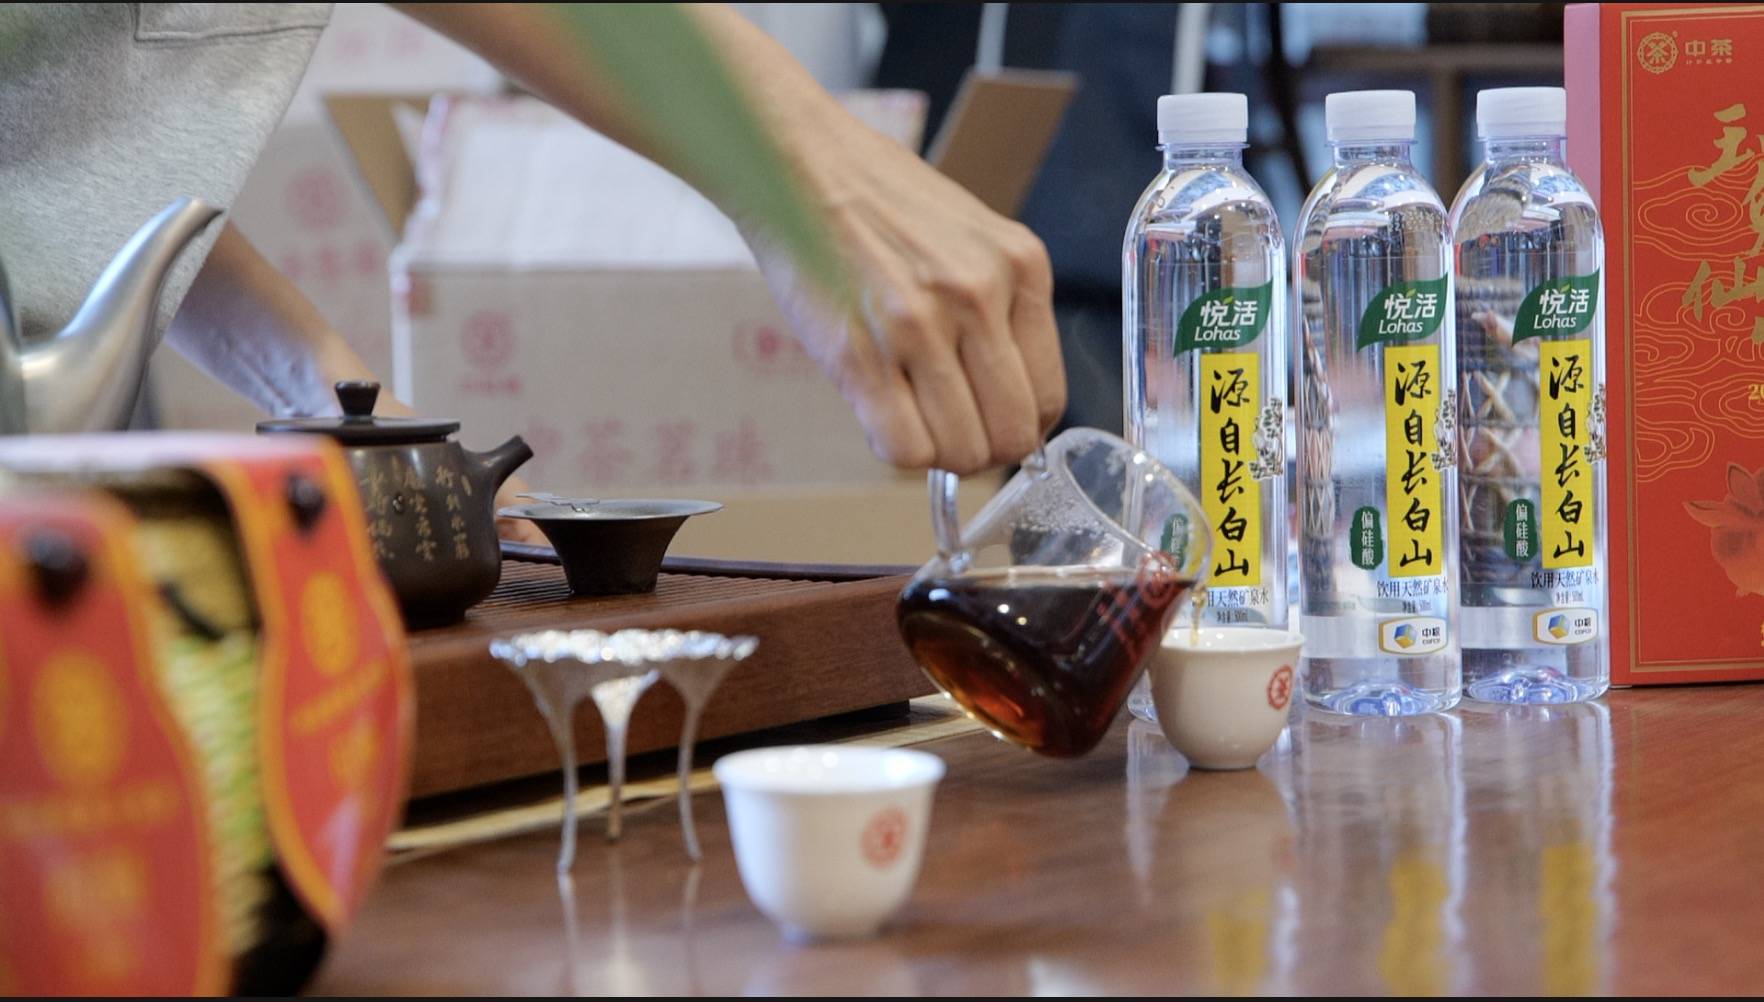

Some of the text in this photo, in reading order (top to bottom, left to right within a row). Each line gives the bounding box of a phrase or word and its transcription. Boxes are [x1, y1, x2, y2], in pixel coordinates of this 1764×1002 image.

[1684, 39, 1733, 56] 中茶
[1200, 299, 1258, 327] 悦活
[1384, 293, 1438, 320] 悦活
[1539, 288, 1590, 315] 悦活
[1194, 325, 1241, 341] Lohas
[1378, 318, 1424, 335] Lohas
[1533, 313, 1577, 329] Lohas
[1394, 359, 1432, 568] 源自长白山
[1549, 354, 1584, 559] 源自长白山
[1210, 367, 1250, 578] 源自长白山
[1361, 510, 1375, 566] 偏硅酸
[1515, 503, 1529, 558] 偏硅酸
